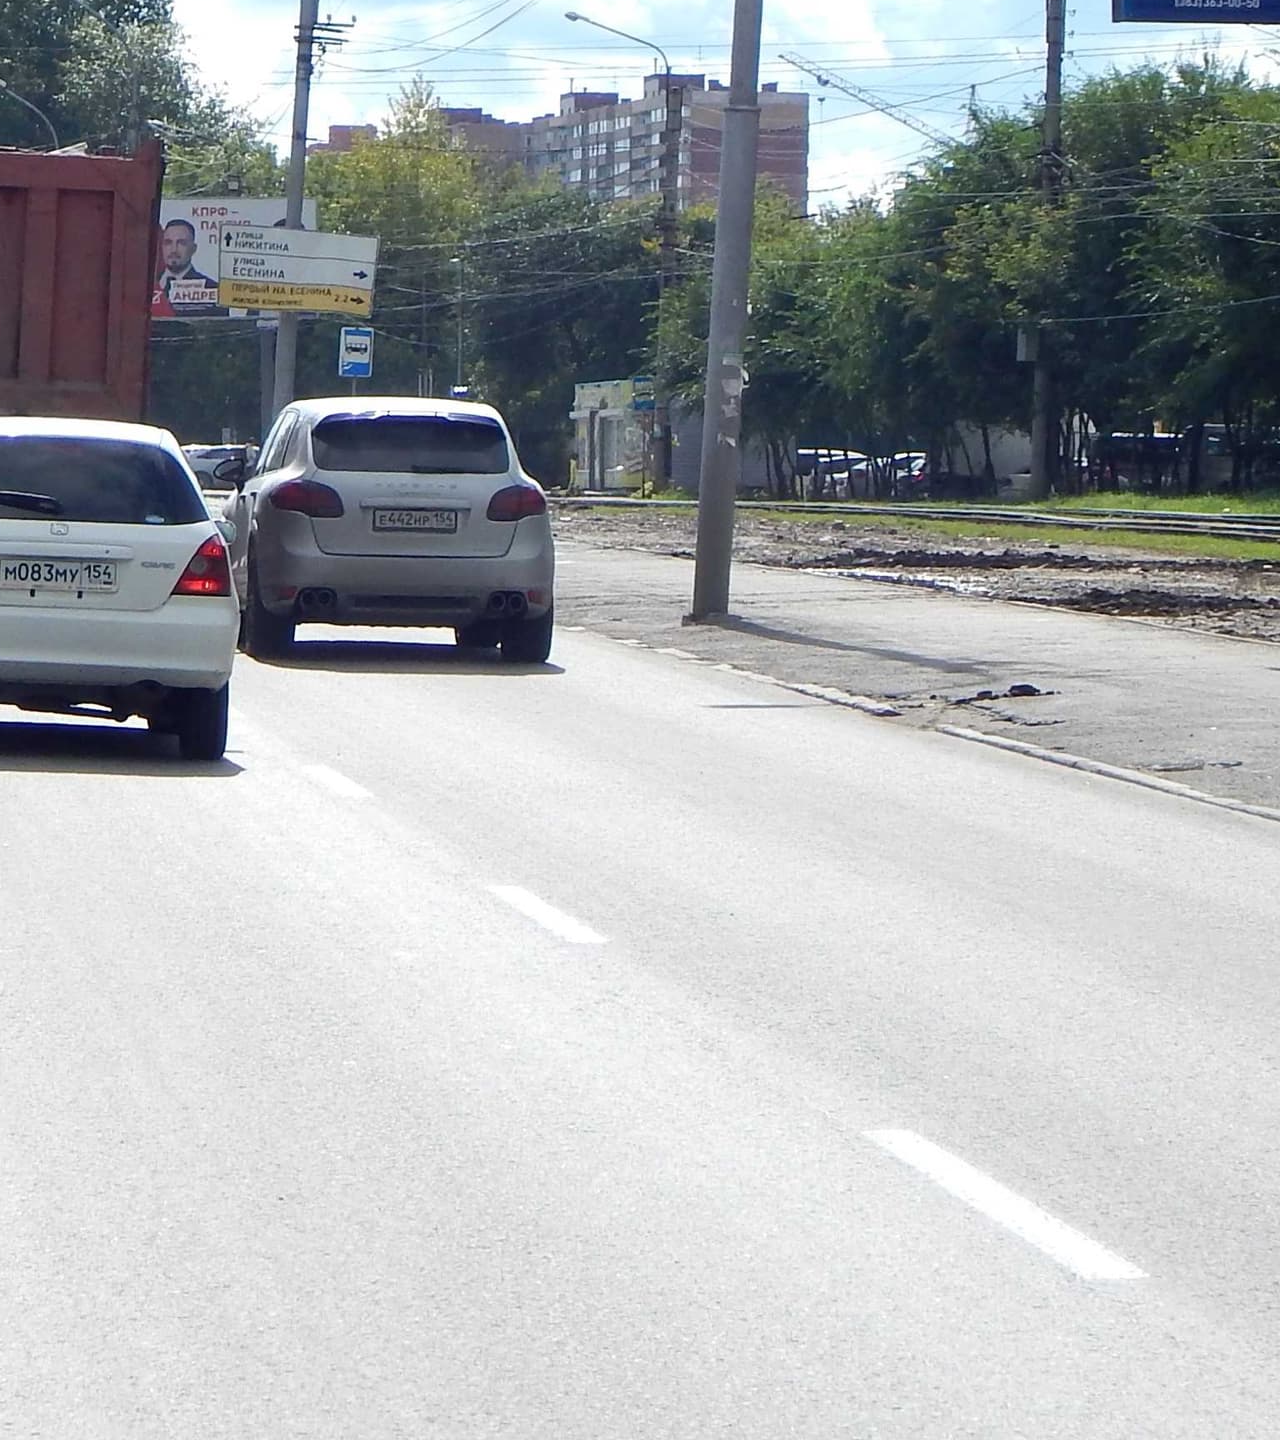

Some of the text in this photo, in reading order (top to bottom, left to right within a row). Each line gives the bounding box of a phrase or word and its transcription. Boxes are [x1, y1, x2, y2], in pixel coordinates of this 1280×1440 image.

[191, 206, 228, 217] КПРФ
[235, 231, 263, 240] улица
[234, 240, 289, 252] НИКИТИНА
[233, 257, 265, 266] улица
[232, 266, 285, 279] ЕСЕНИНА
[272, 285, 286, 295] НА
[379, 512, 453, 526] Е442НР 154
[4, 562, 112, 583] М083МУ 154
